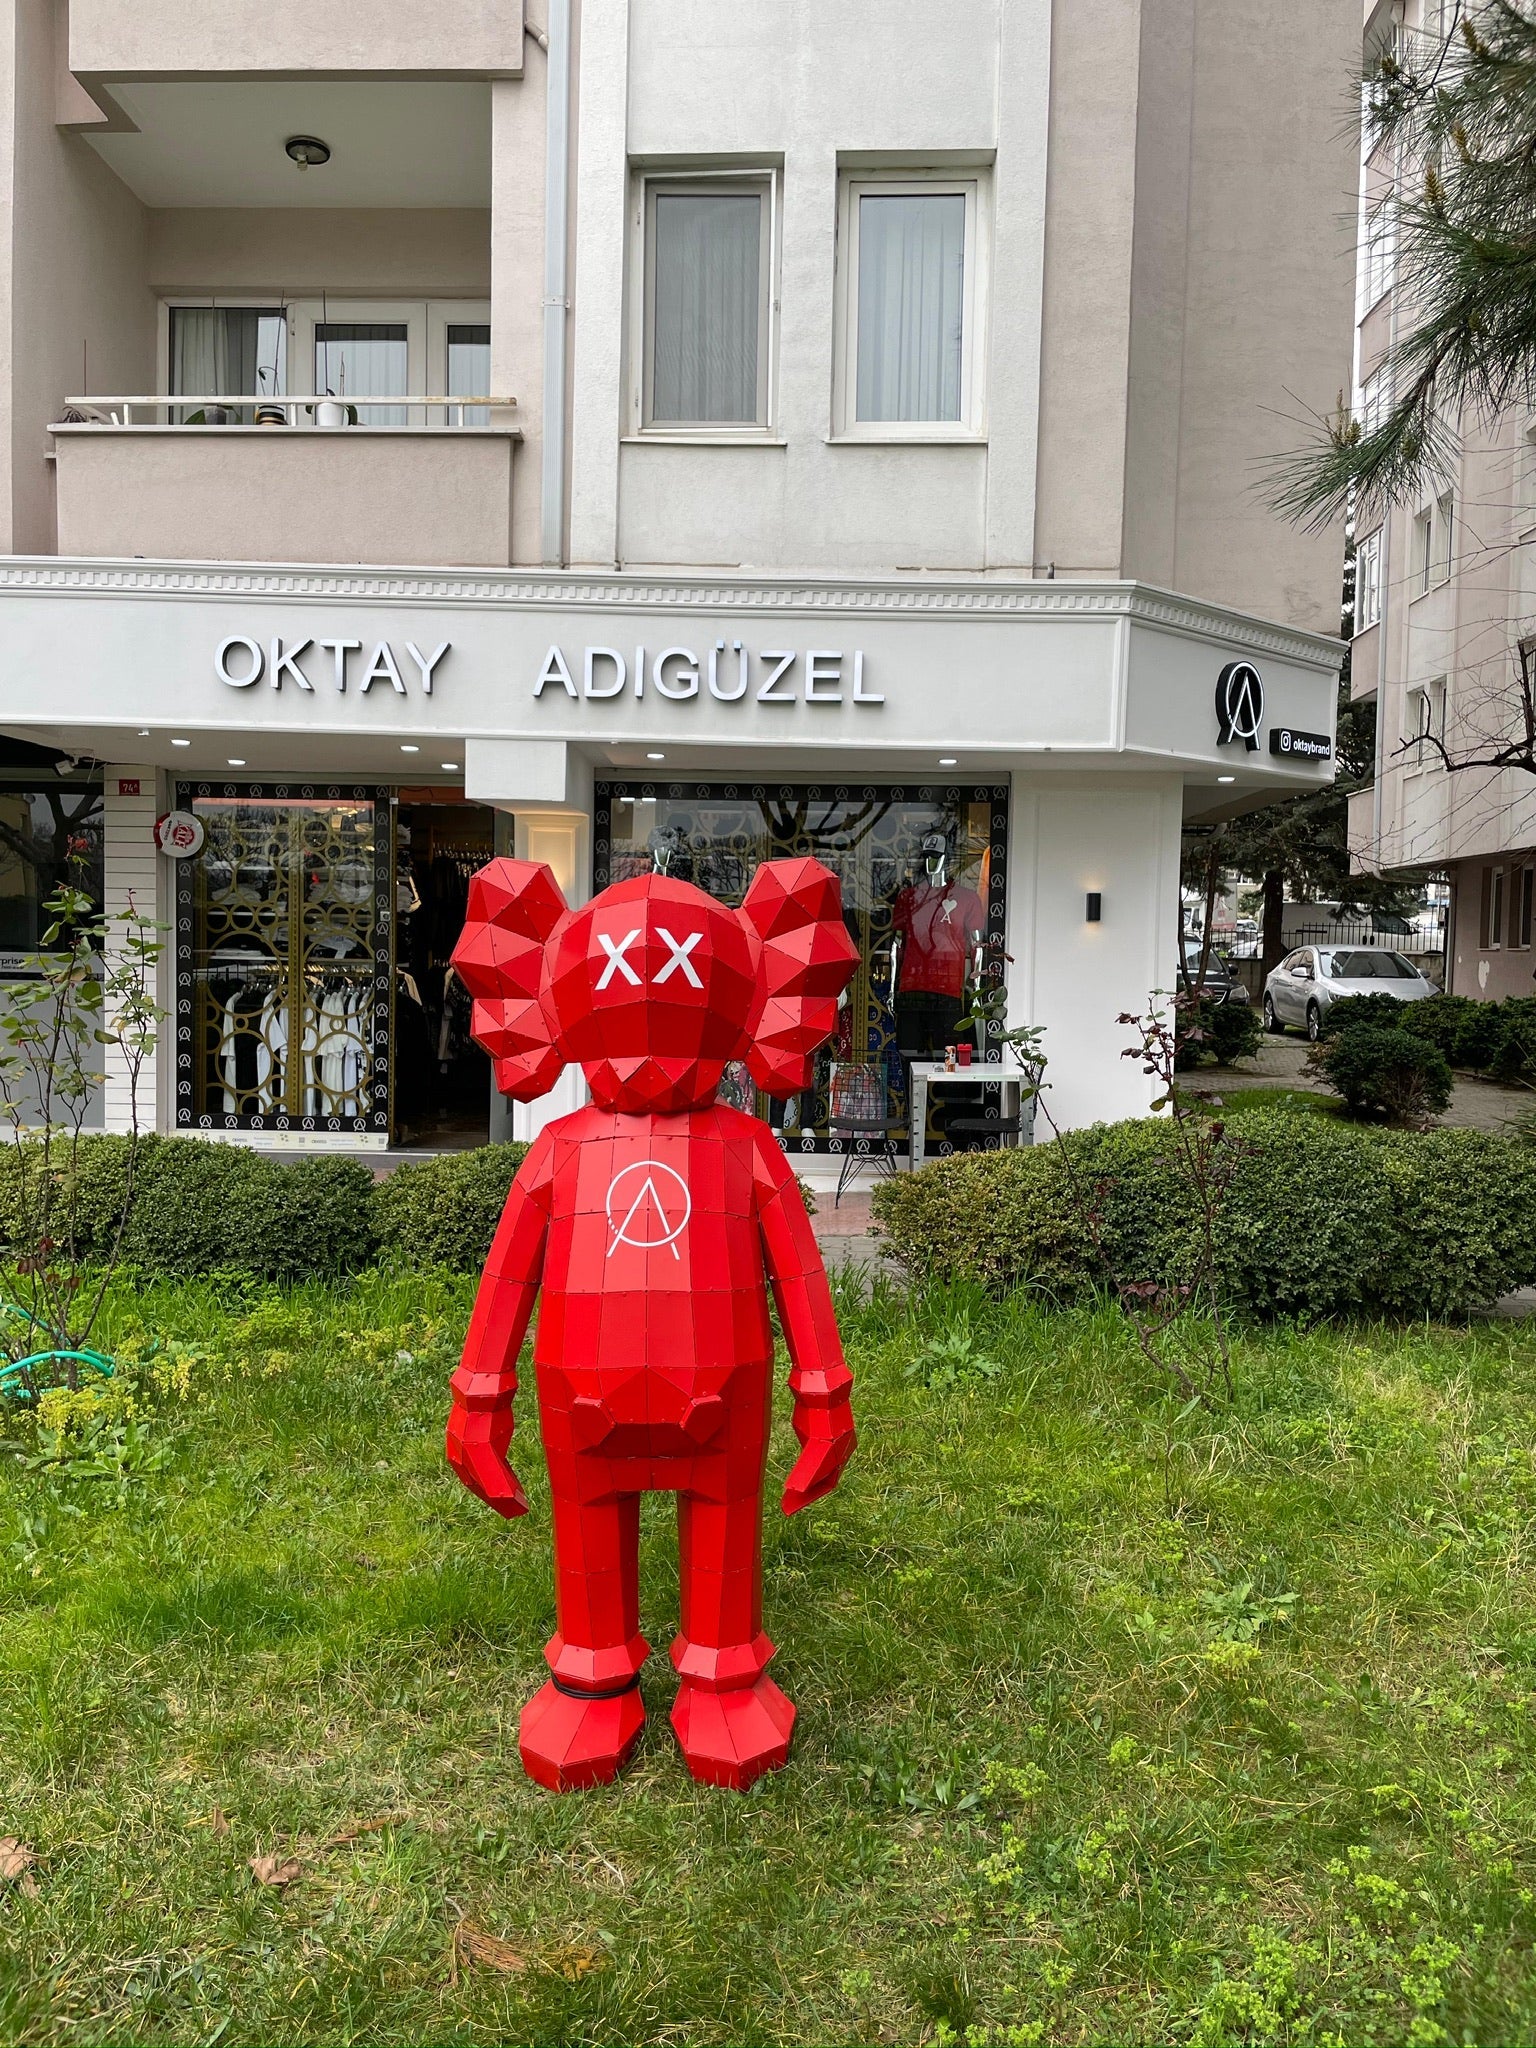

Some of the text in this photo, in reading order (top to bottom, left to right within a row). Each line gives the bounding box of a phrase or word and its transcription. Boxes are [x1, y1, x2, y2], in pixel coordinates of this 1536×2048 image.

[214, 635, 885, 702] OKTAY ADIGÜZEL
[1293, 738, 1331, 756] oktaybrand
[170, 820, 193, 849] KALE
